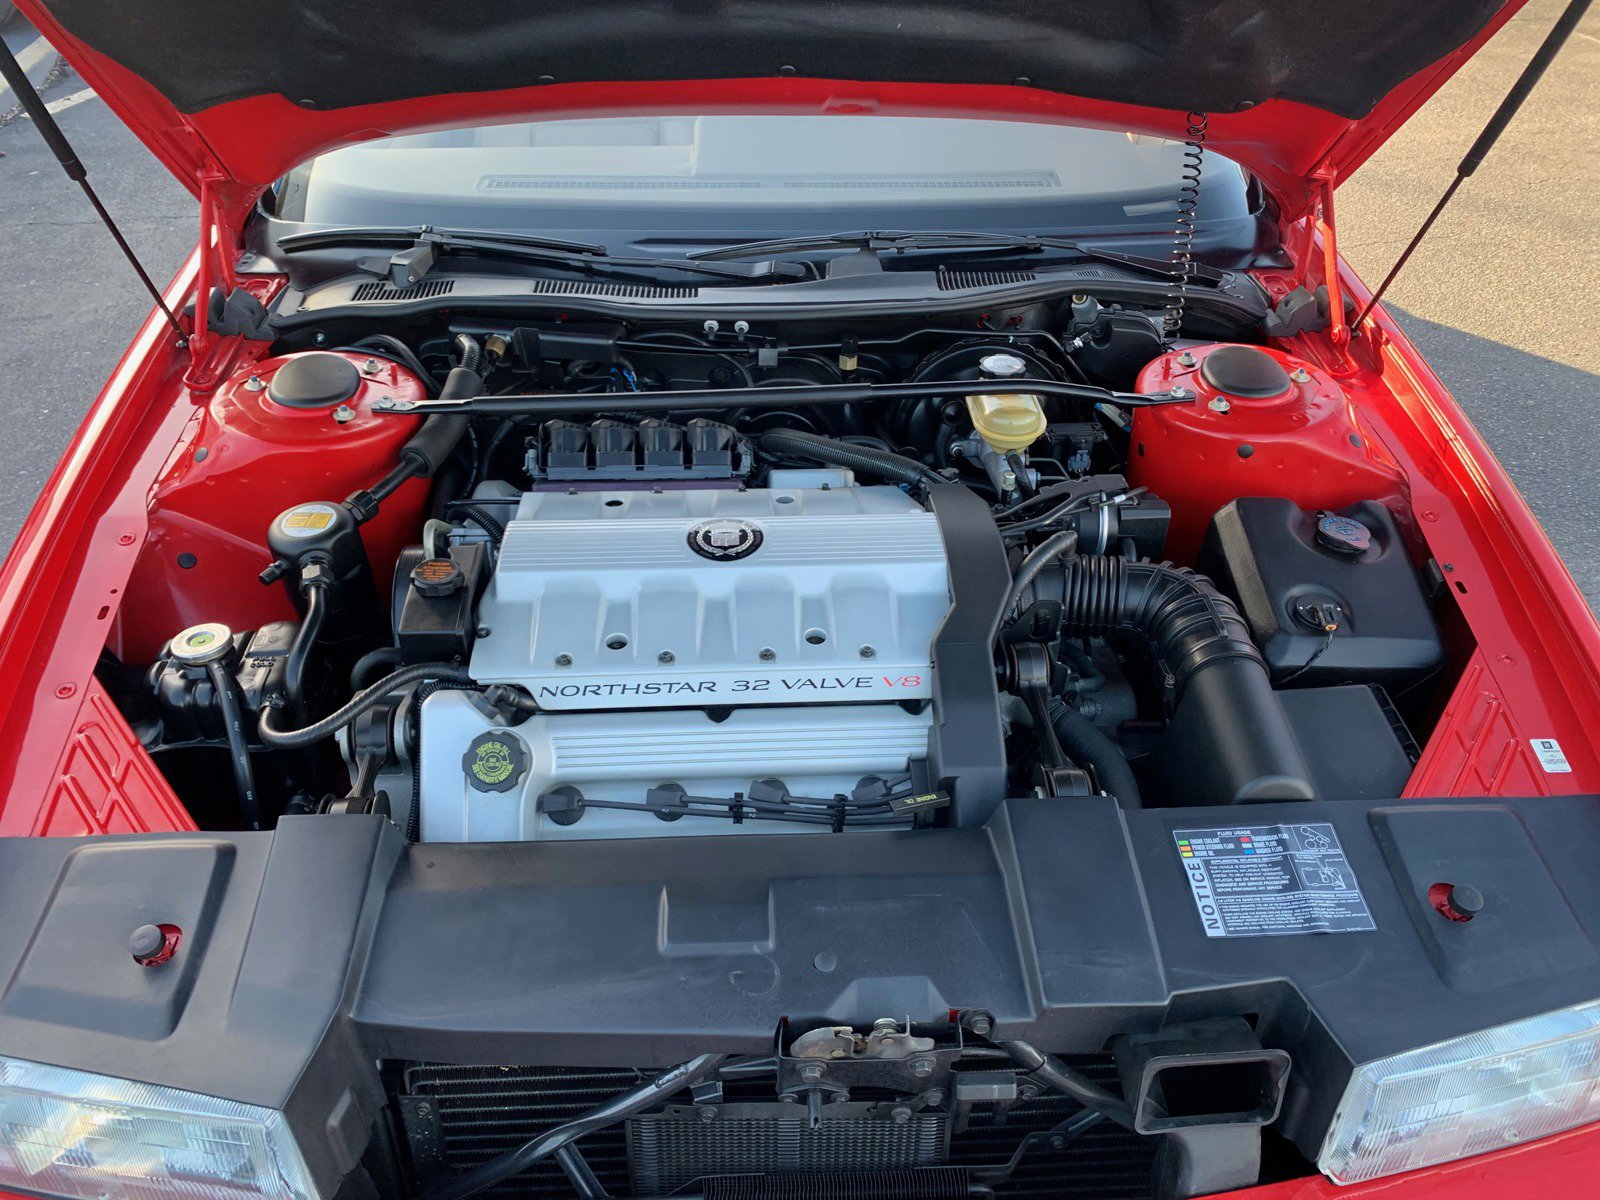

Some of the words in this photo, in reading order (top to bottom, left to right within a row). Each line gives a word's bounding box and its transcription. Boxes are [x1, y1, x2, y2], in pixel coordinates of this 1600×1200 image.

[539, 680, 717, 698] NORTHSTAR
[731, 679, 770, 692] 32
[781, 676, 874, 690] VALVE
[882, 675, 921, 688] V8
[1188, 863, 1220, 930] NOTICE
